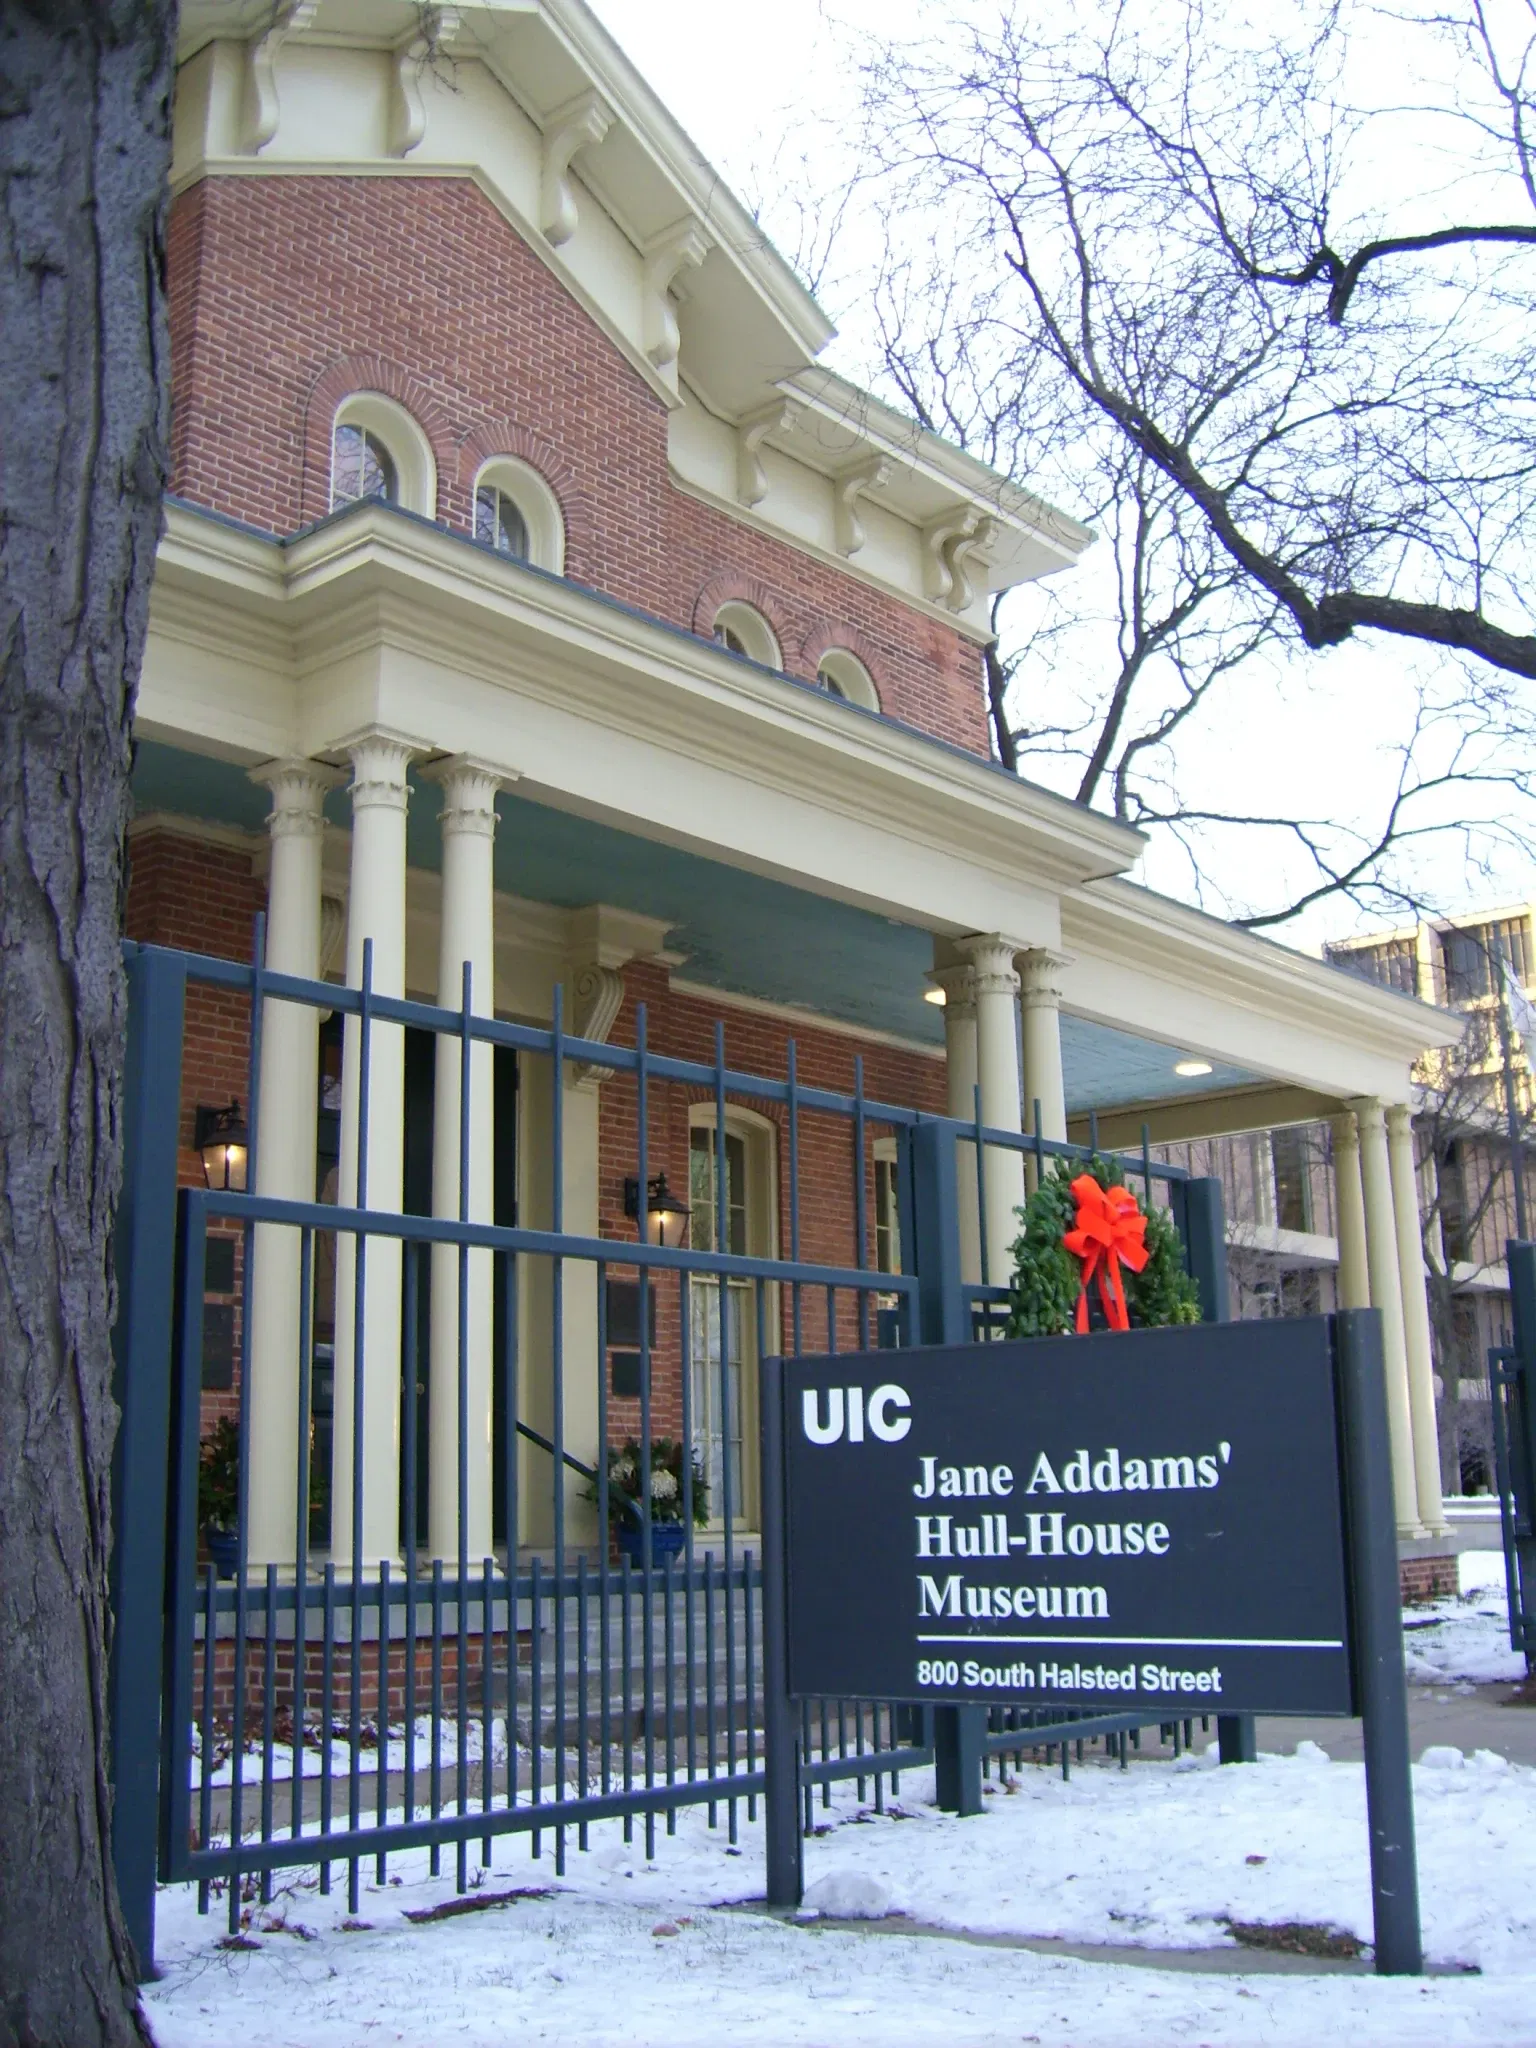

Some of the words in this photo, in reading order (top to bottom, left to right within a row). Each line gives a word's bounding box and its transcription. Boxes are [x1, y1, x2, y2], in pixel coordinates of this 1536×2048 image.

[802, 1383, 912, 1444] UIC
[912, 1457, 1014, 1499] Jane
[1025, 1441, 1231, 1495] Addams'
[914, 1512, 1170, 1558] Hull-House
[916, 1574, 1111, 1618] Museum
[916, 1660, 959, 1686] 800
[962, 1660, 1035, 1688] South
[1039, 1662, 1137, 1691] Halsted
[1140, 1663, 1223, 1693] Street
